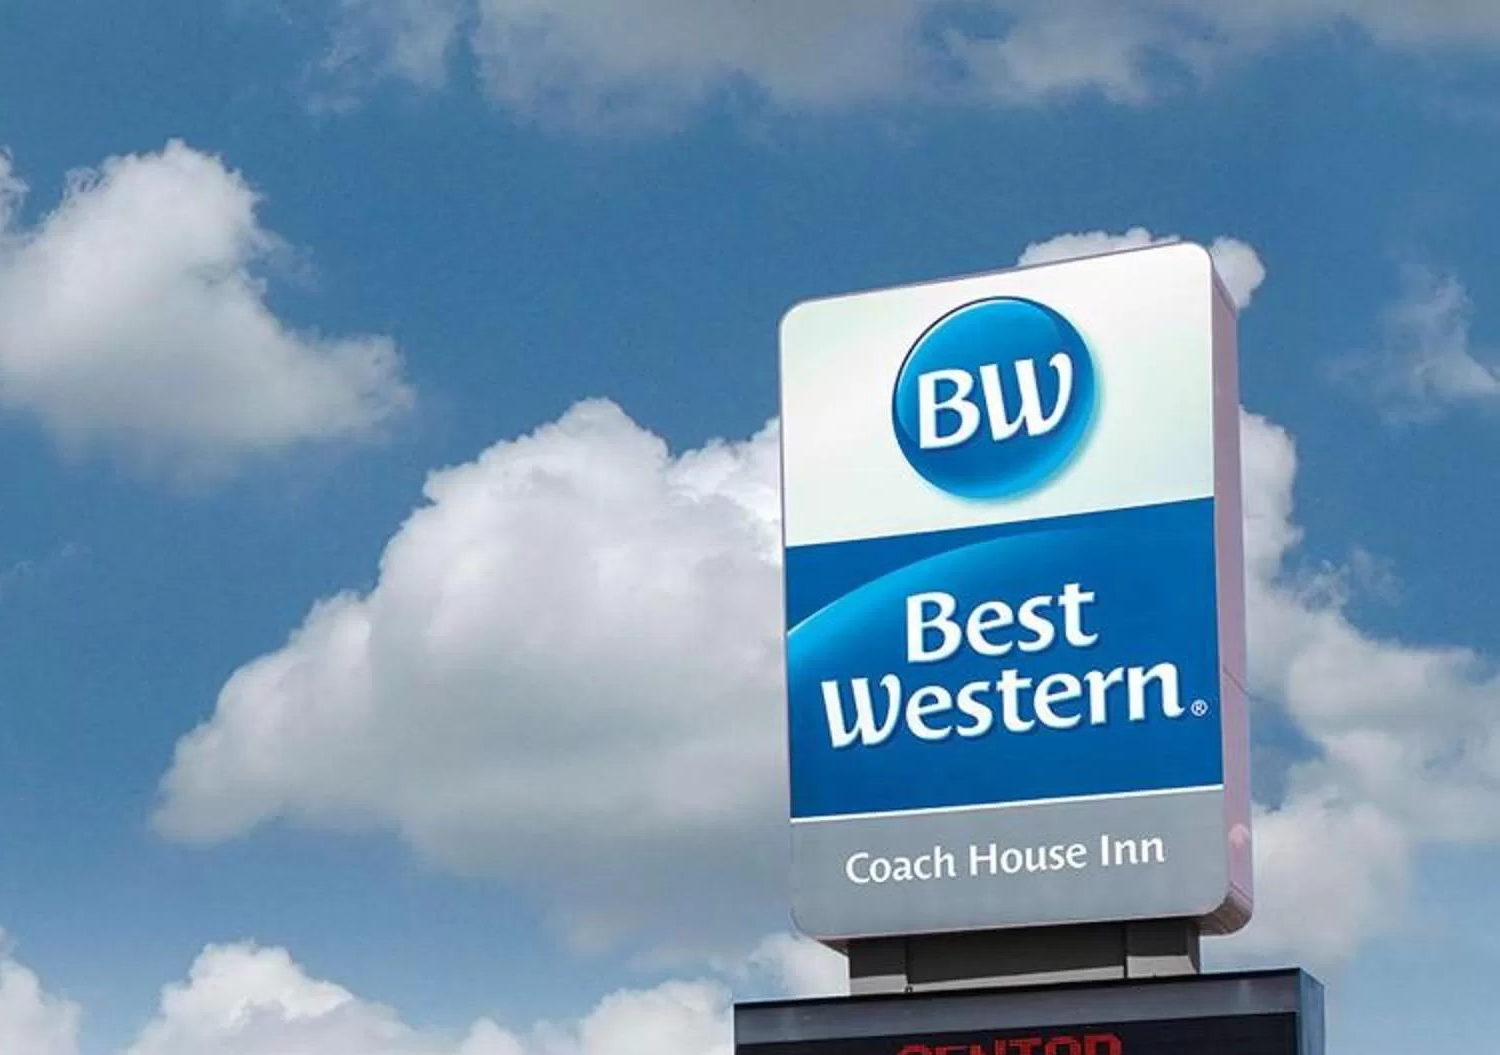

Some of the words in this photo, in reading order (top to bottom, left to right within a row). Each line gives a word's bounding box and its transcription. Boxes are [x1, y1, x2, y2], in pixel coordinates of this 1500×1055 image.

[918, 353, 1073, 449] BW
[906, 583, 1097, 662] Best
[845, 845, 957, 884] Coach
[969, 843, 1088, 877] House
[1100, 834, 1166, 867] Inn
